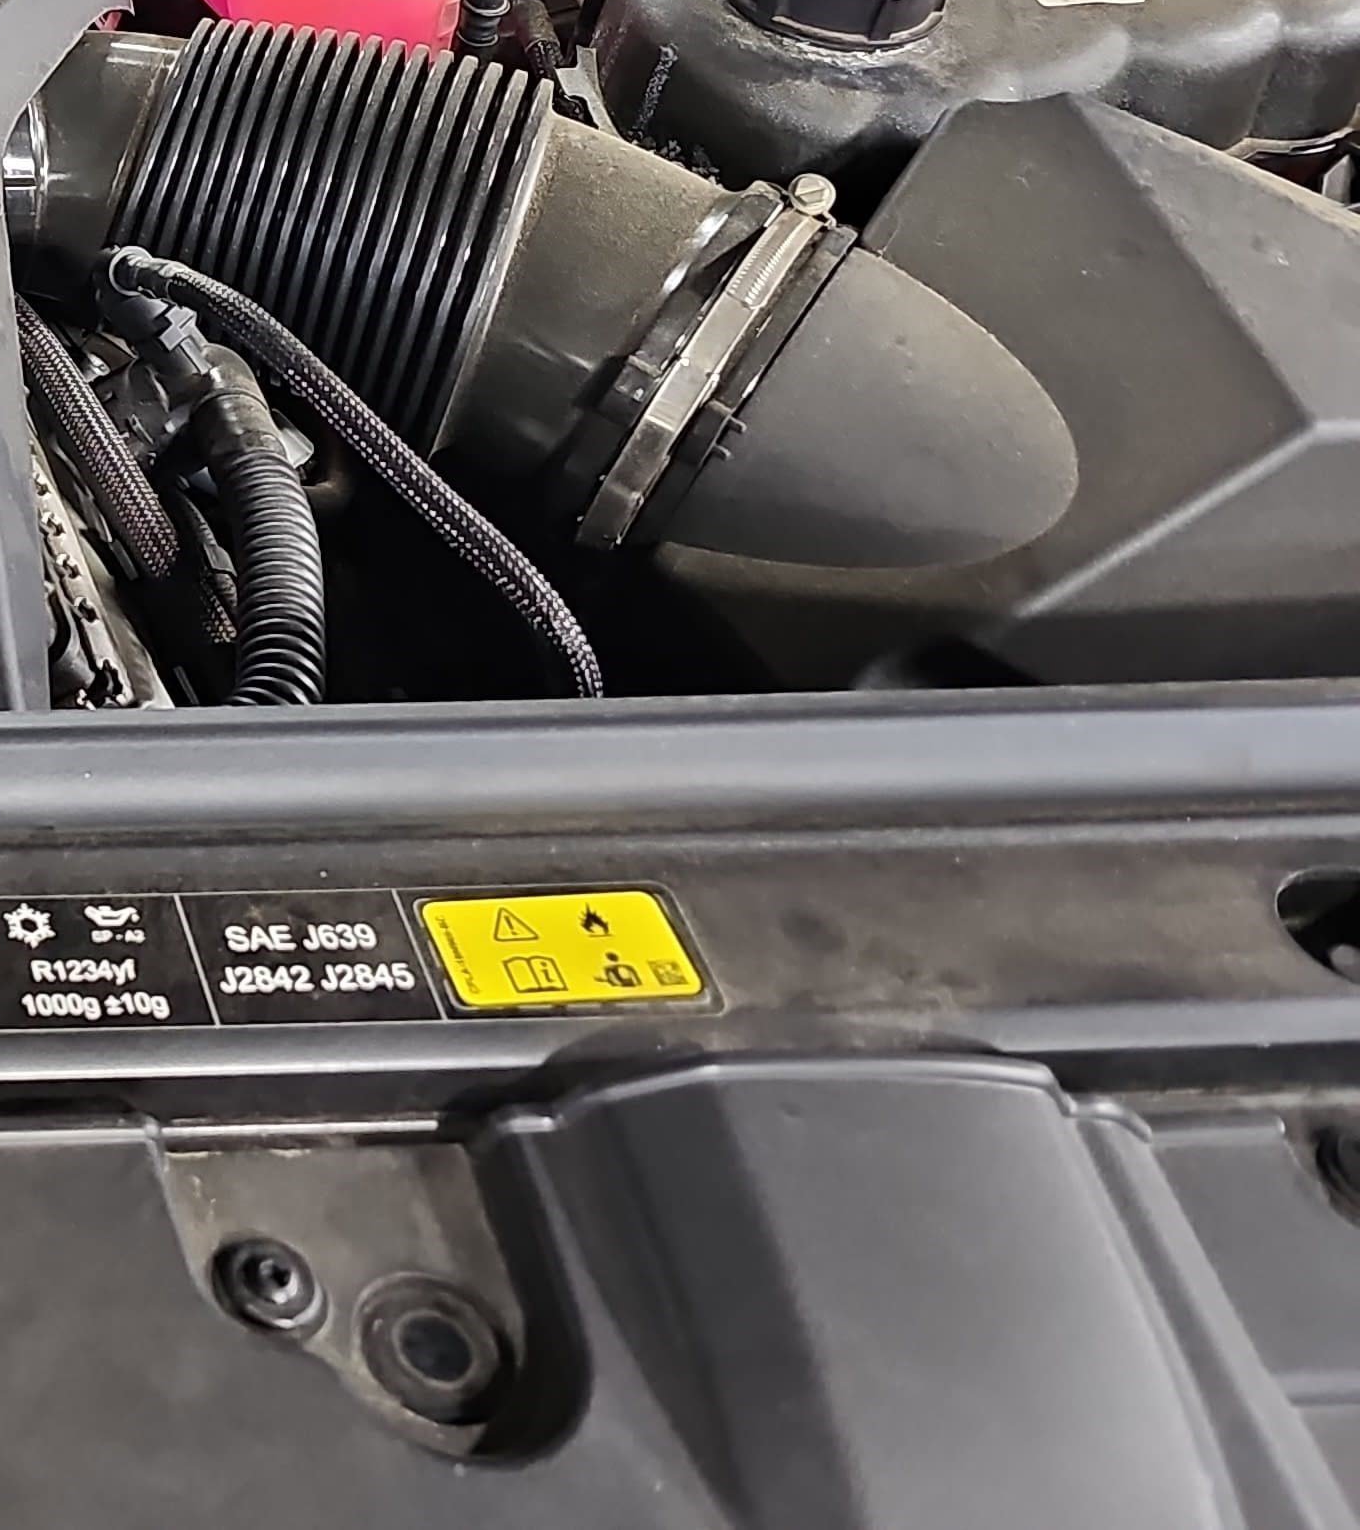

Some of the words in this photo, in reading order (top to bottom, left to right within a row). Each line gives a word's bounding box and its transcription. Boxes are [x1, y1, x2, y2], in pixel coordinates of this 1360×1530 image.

[224, 924, 298, 953] SAE
[302, 923, 378, 952] J639
[30, 958, 138, 986] R1234yf
[219, 964, 316, 995] J2842
[319, 962, 416, 993] J2845
[21, 992, 103, 1021] 1000g
[103, 990, 171, 1020] ±10g
